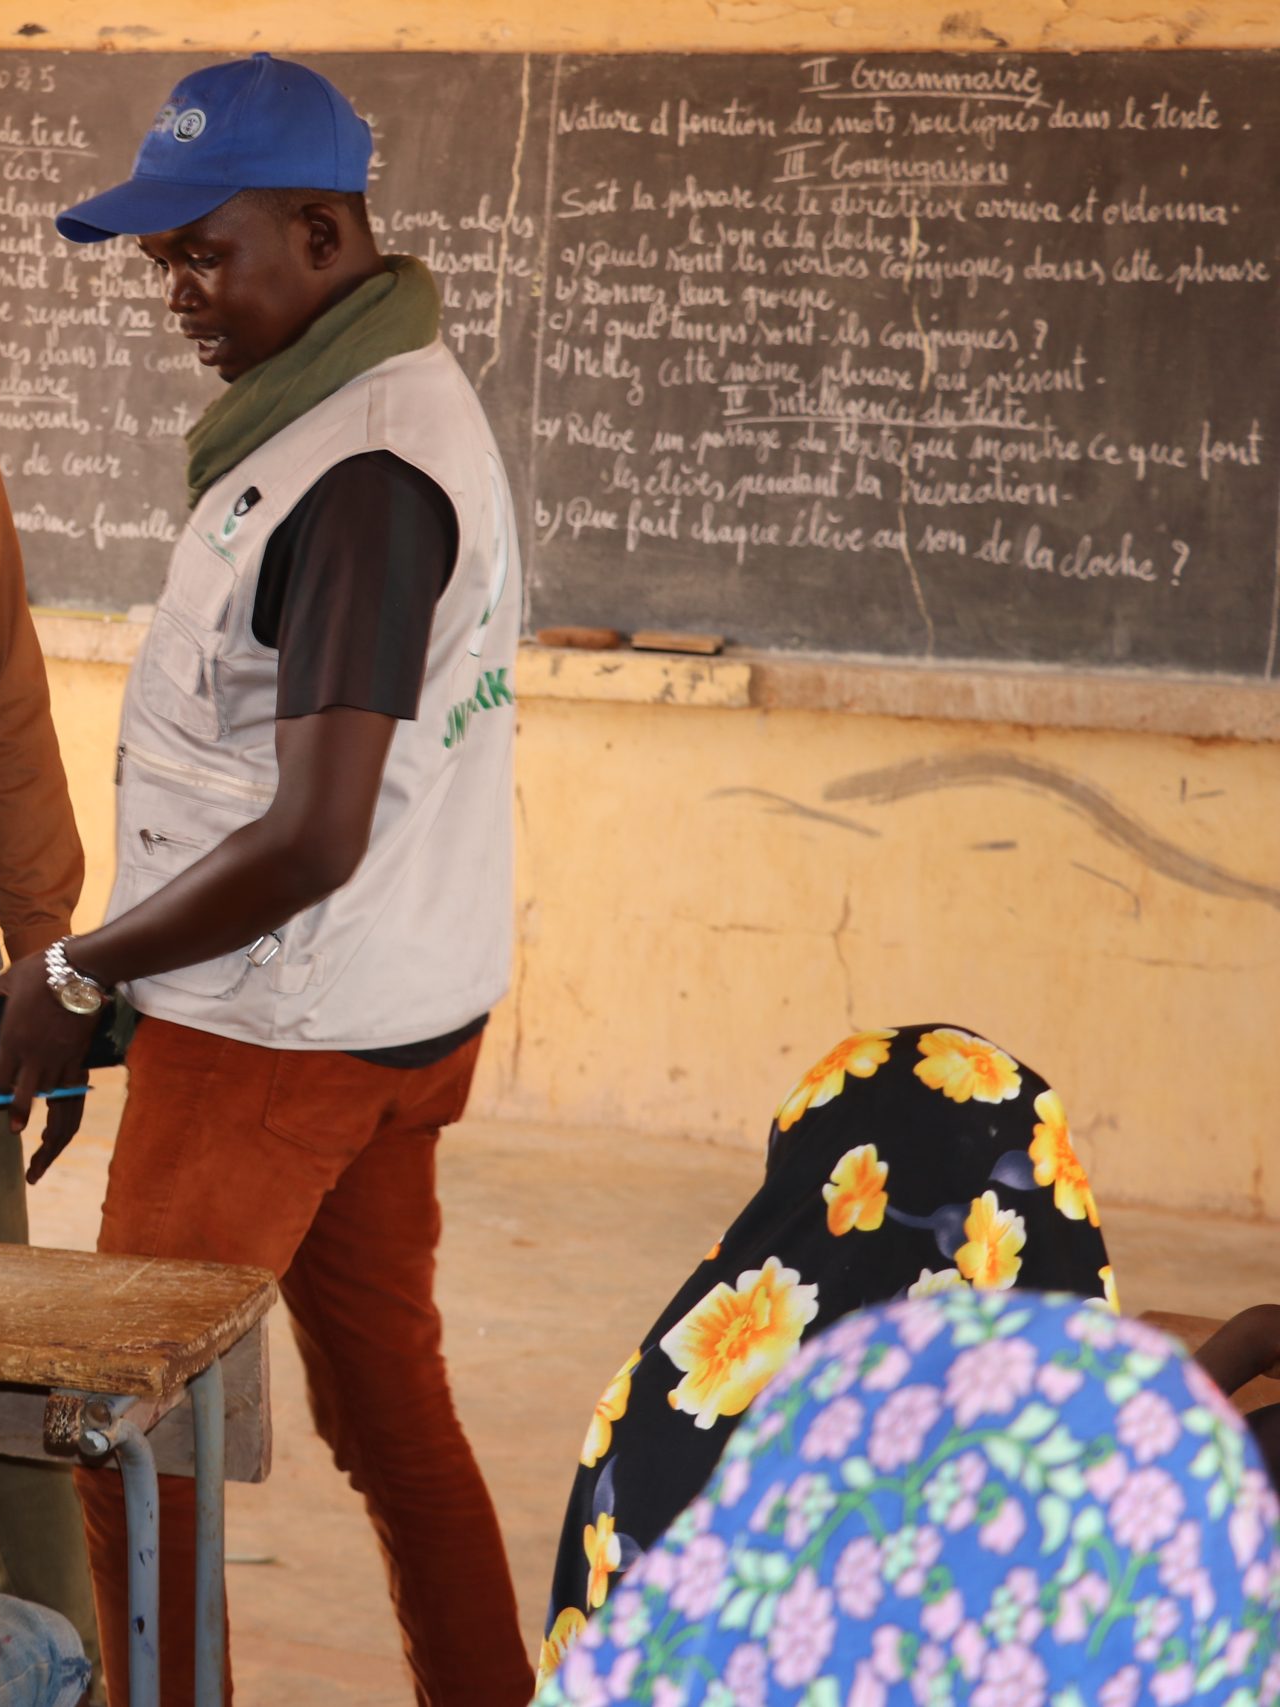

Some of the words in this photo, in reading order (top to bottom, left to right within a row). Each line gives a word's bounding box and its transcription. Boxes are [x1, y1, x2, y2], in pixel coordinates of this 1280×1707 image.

[850, 57, 1043, 97] Grammaire
[557, 96, 643, 136] Nature
[1047, 98, 1111, 130] dans
[1150, 90, 1222, 130] texte
[90, 501, 178, 551] famille
